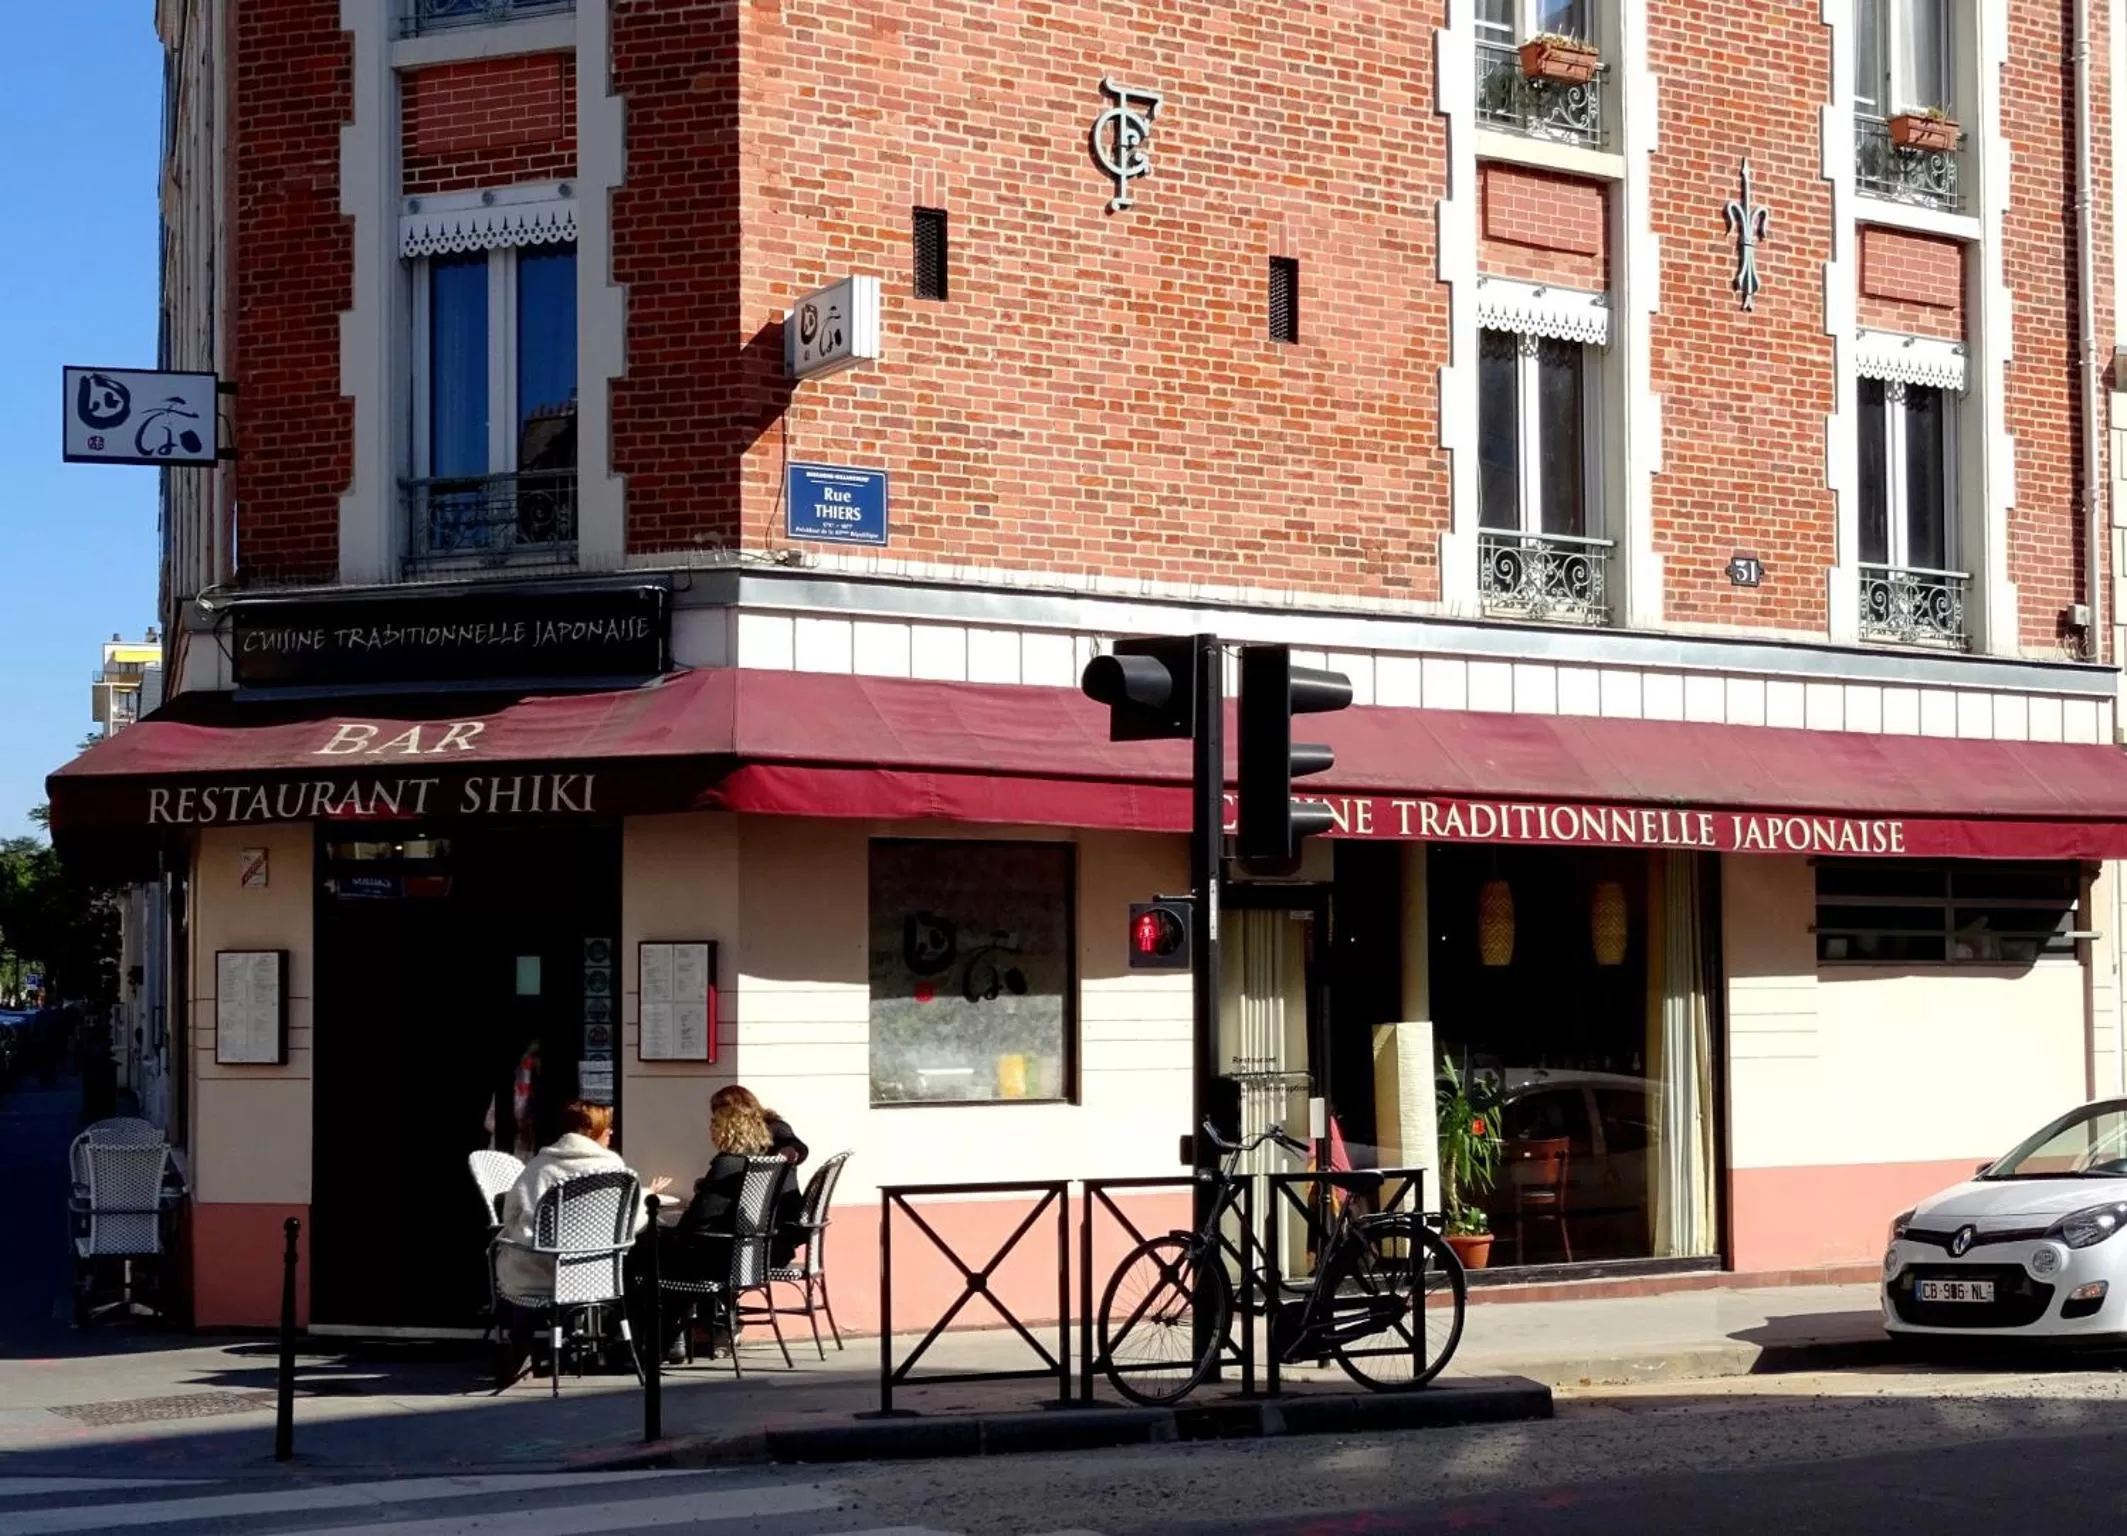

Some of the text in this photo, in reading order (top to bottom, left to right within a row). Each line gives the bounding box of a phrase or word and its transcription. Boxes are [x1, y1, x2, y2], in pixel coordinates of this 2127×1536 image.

[814, 504, 862, 521] THIERS
[823, 487, 852, 503] Rue
[243, 616, 650, 653] CUISINE TRADITIONNELLE JAPONAISE
[312, 722, 486, 755] BAR
[146, 774, 597, 825] RESTAURANT SHIKI
[1391, 799, 1717, 847] TRADITIONNELLE
[1731, 815, 1906, 853] JAPONAISE
